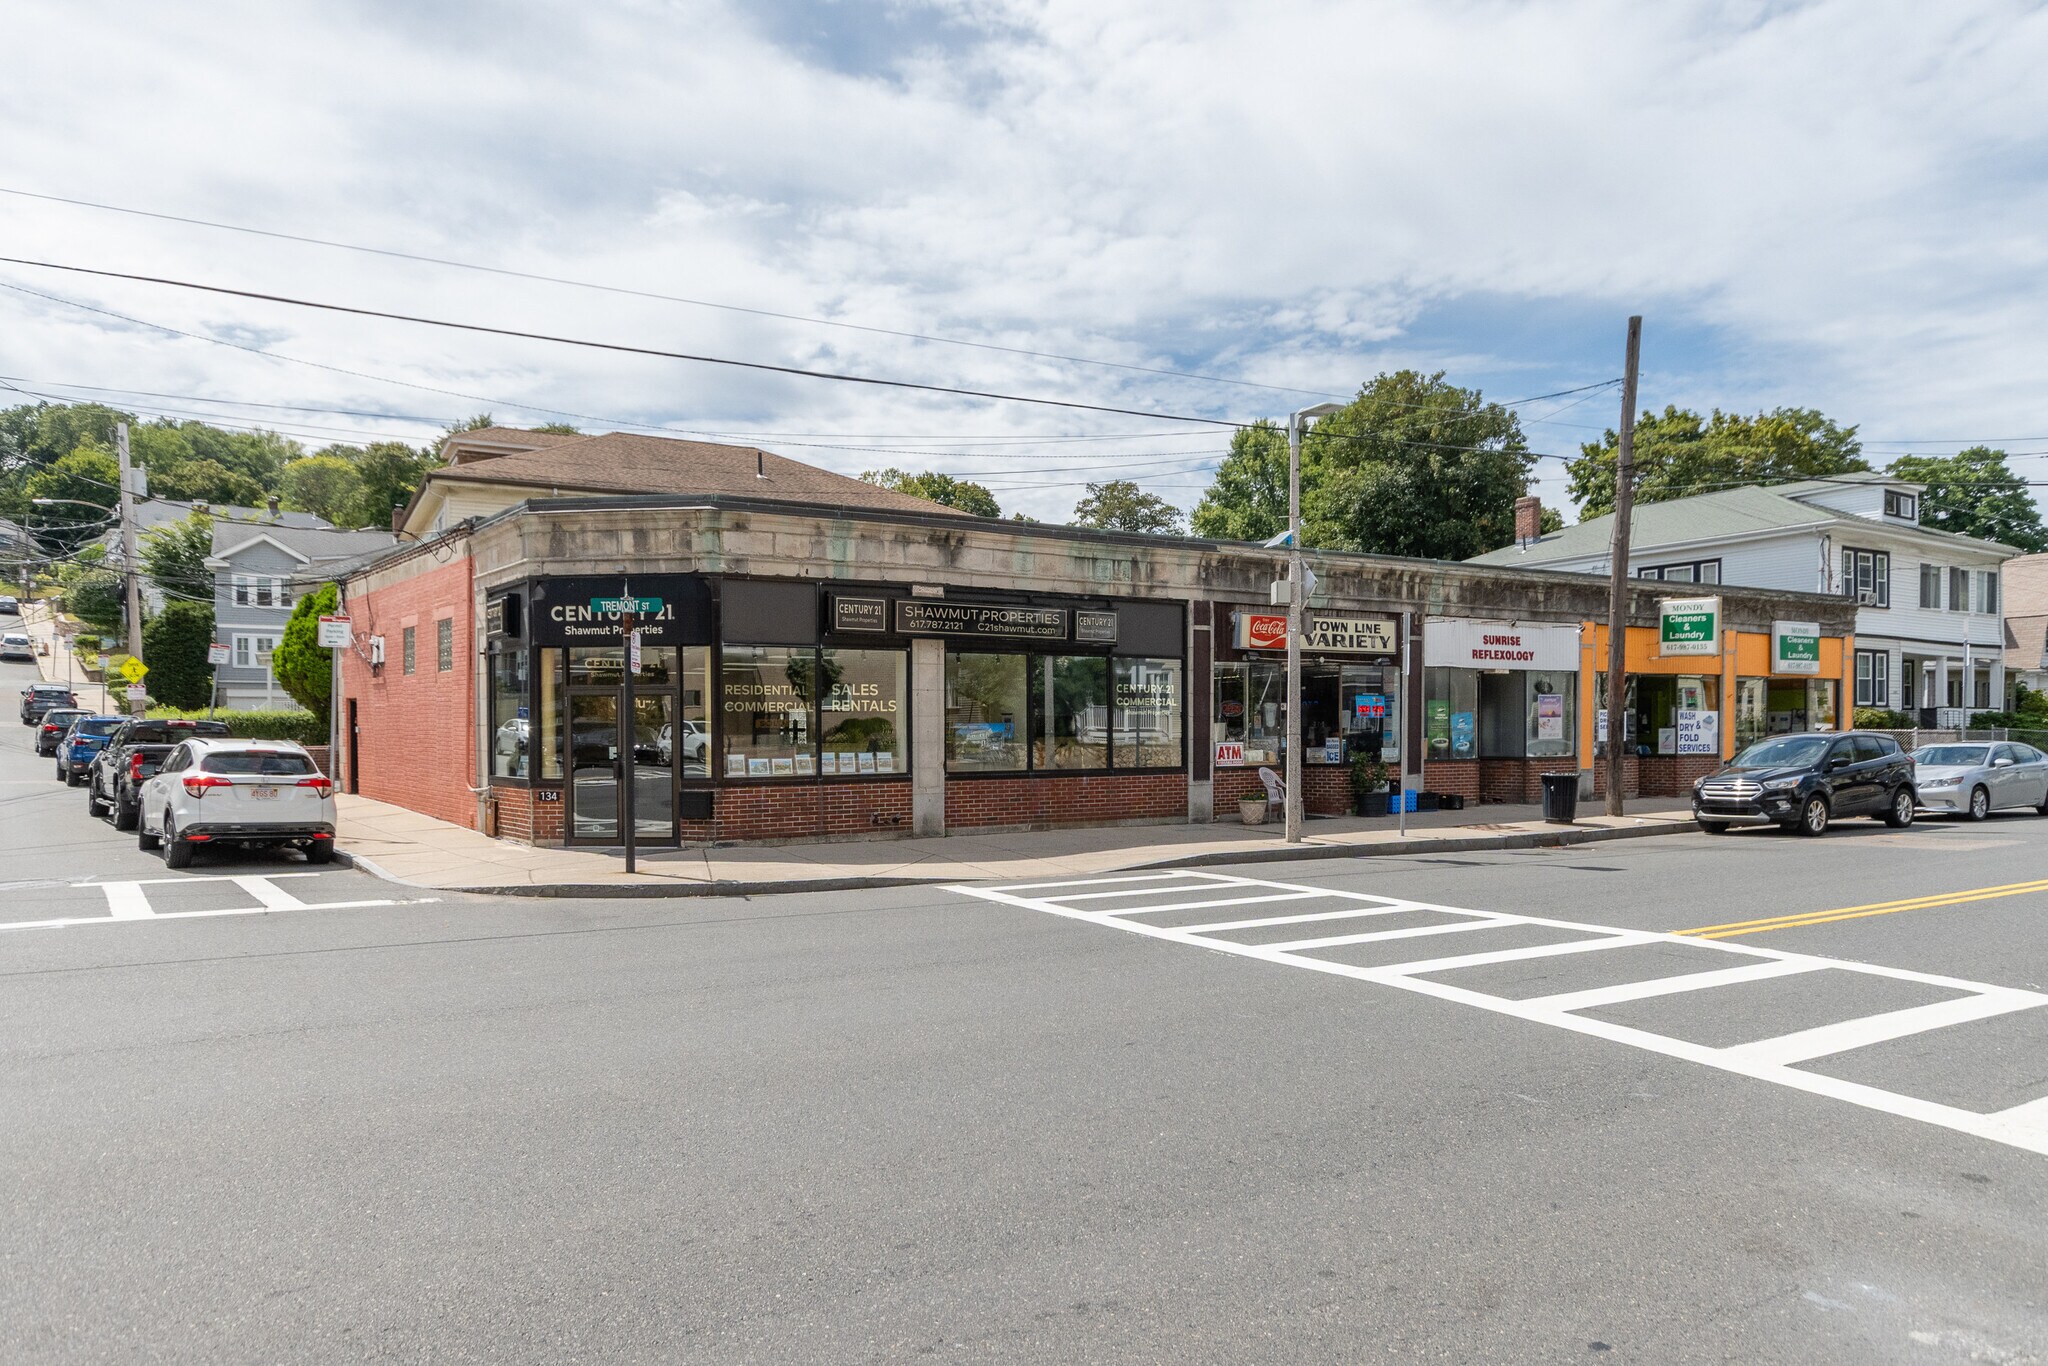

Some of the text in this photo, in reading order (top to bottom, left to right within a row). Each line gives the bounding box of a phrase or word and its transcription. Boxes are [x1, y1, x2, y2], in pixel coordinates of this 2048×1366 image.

[600, 600, 650, 612] TREMONT ST
[839, 603, 882, 616] CENTURY 21
[905, 606, 1060, 625] SHAWMUT PROPERTIES
[1079, 616, 1106, 626] CENTURY
[565, 625, 663, 635] Shawmut Prerties
[910, 620, 1056, 635] 617.787.2121 C21shawmut.com
[1313, 620, 1381, 634] TOWN LINE
[1304, 633, 1391, 649] VARIETY
[1483, 635, 1521, 646] SUNRISE
[1670, 631, 1705, 640] Laundry
[1787, 636, 1814, 644] Cleaners
[1472, 649, 1534, 661] REFLEXOLOGY
[1788, 652, 1813, 660] Laundry
[725, 683, 879, 696] RESIDENTIAL SALES
[1116, 684, 1175, 694] CENTURY 21
[725, 699, 898, 712] COMMERCIAL RENTALS
[1116, 697, 1176, 706] COMMERCIAL
[1680, 712, 1696, 720] WASH
[1680, 720, 1701, 731] DRY &
[1218, 746, 1241, 759] ATM
[1679, 744, 1711, 752] SERVICES
[1327, 751, 1339, 761] ICE
[540, 791, 557, 801] 134
